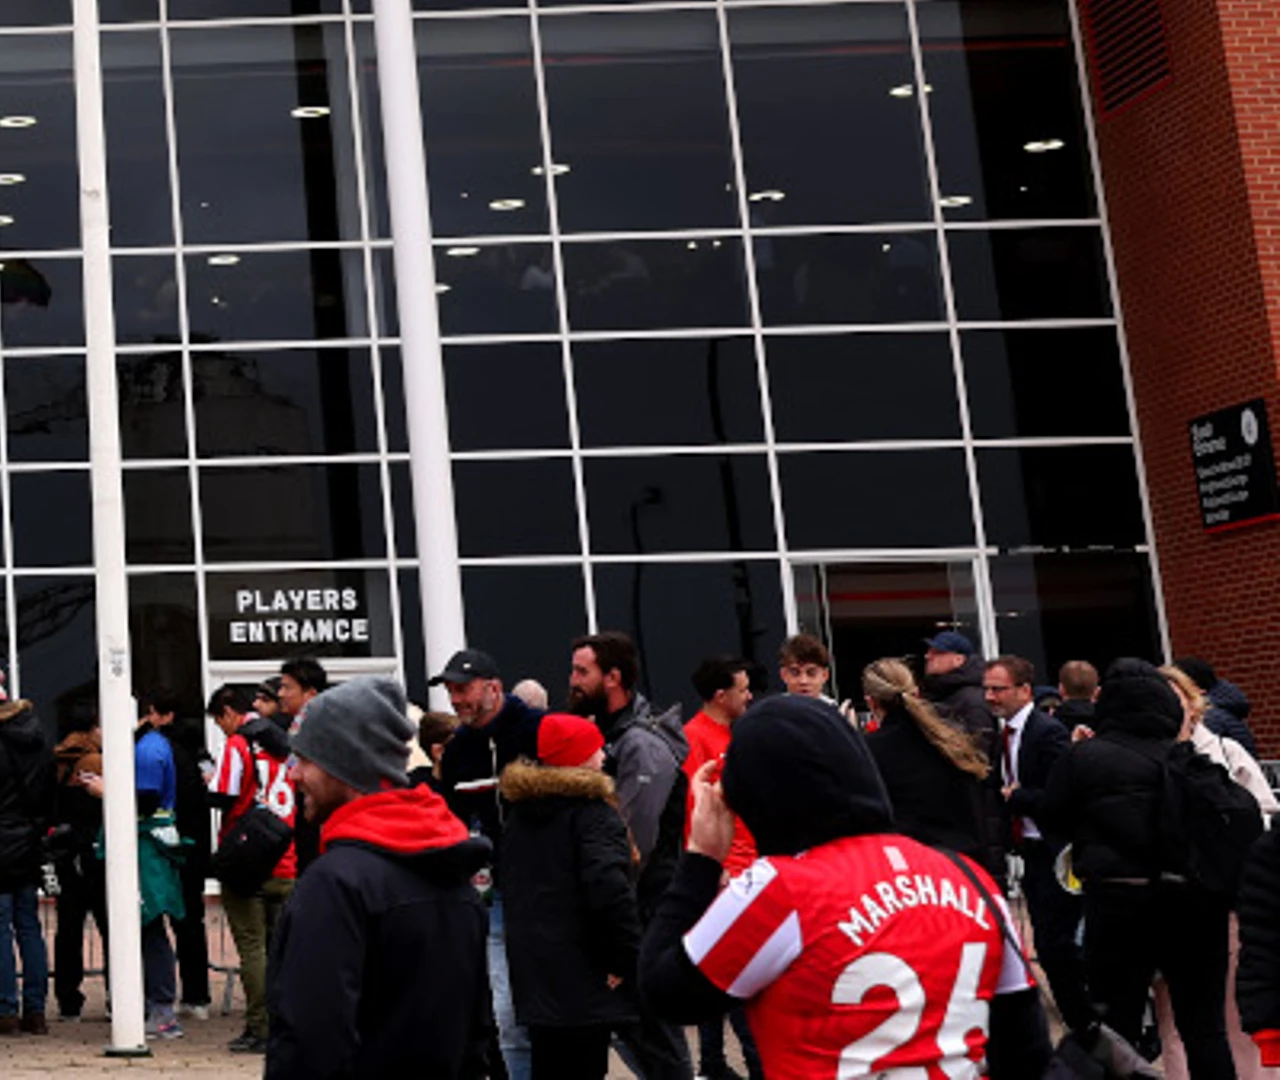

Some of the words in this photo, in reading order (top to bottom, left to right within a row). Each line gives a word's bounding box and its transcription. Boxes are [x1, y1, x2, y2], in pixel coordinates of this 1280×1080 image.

[235, 587, 358, 613] PLAYERS
[229, 618, 369, 643] ENTRANCE
[838, 874, 992, 947] MARSHALL
[831, 941, 990, 1080] 26
